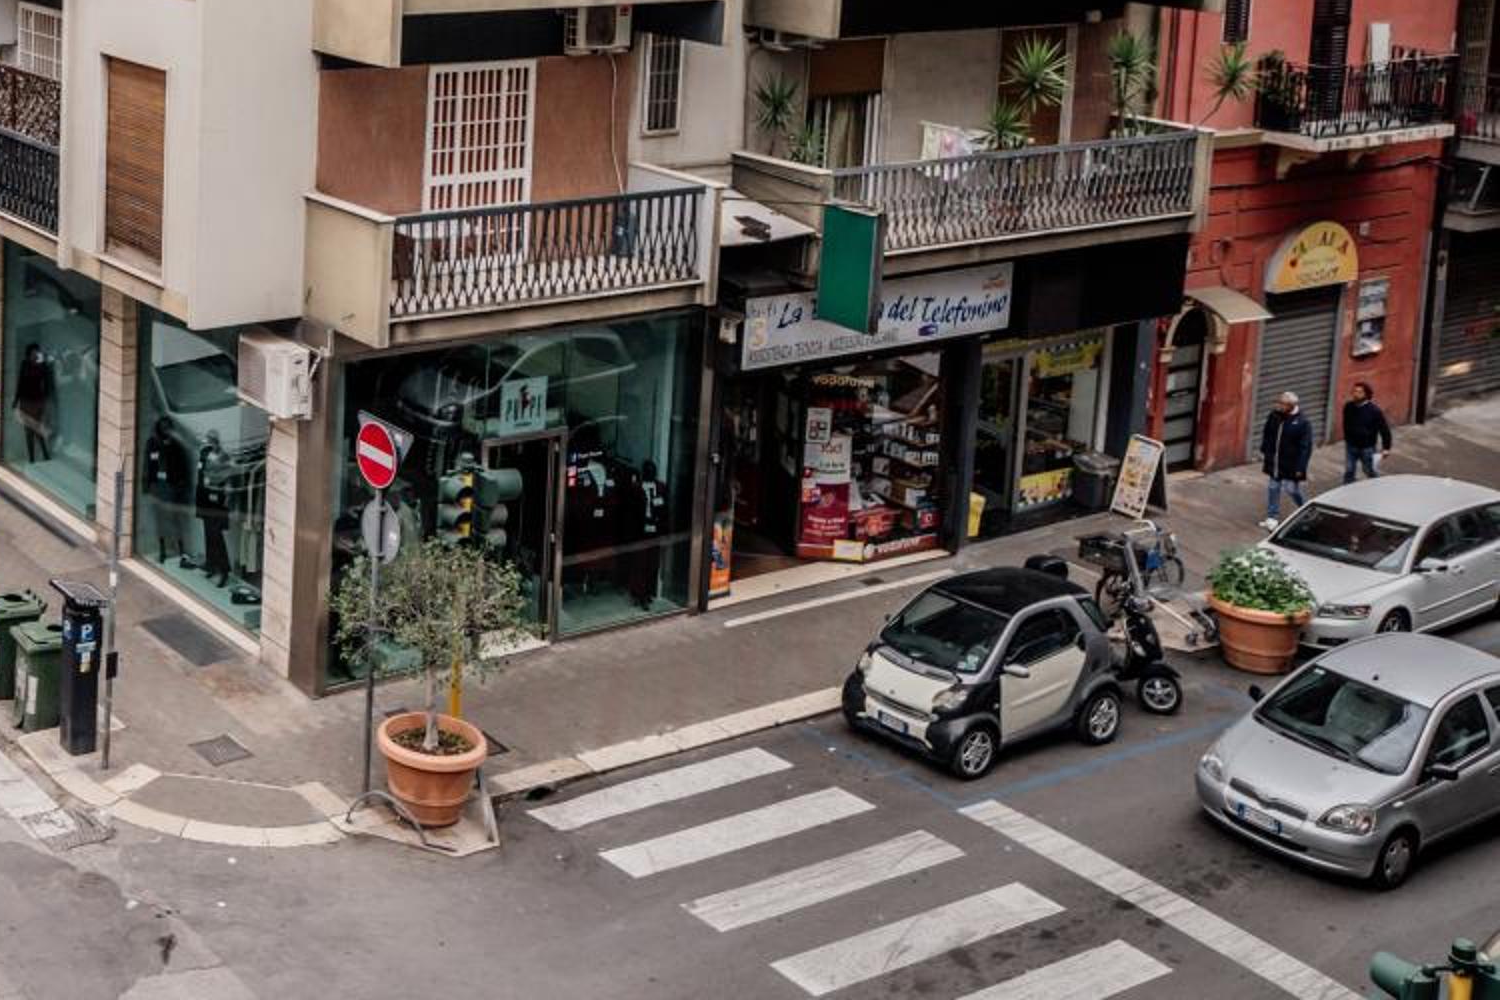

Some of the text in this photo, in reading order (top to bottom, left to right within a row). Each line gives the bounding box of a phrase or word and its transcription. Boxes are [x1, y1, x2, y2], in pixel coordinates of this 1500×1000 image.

[777, 302, 803, 329] La
[887, 294, 918, 321] del
[920, 293, 1008, 329] Telefonino
